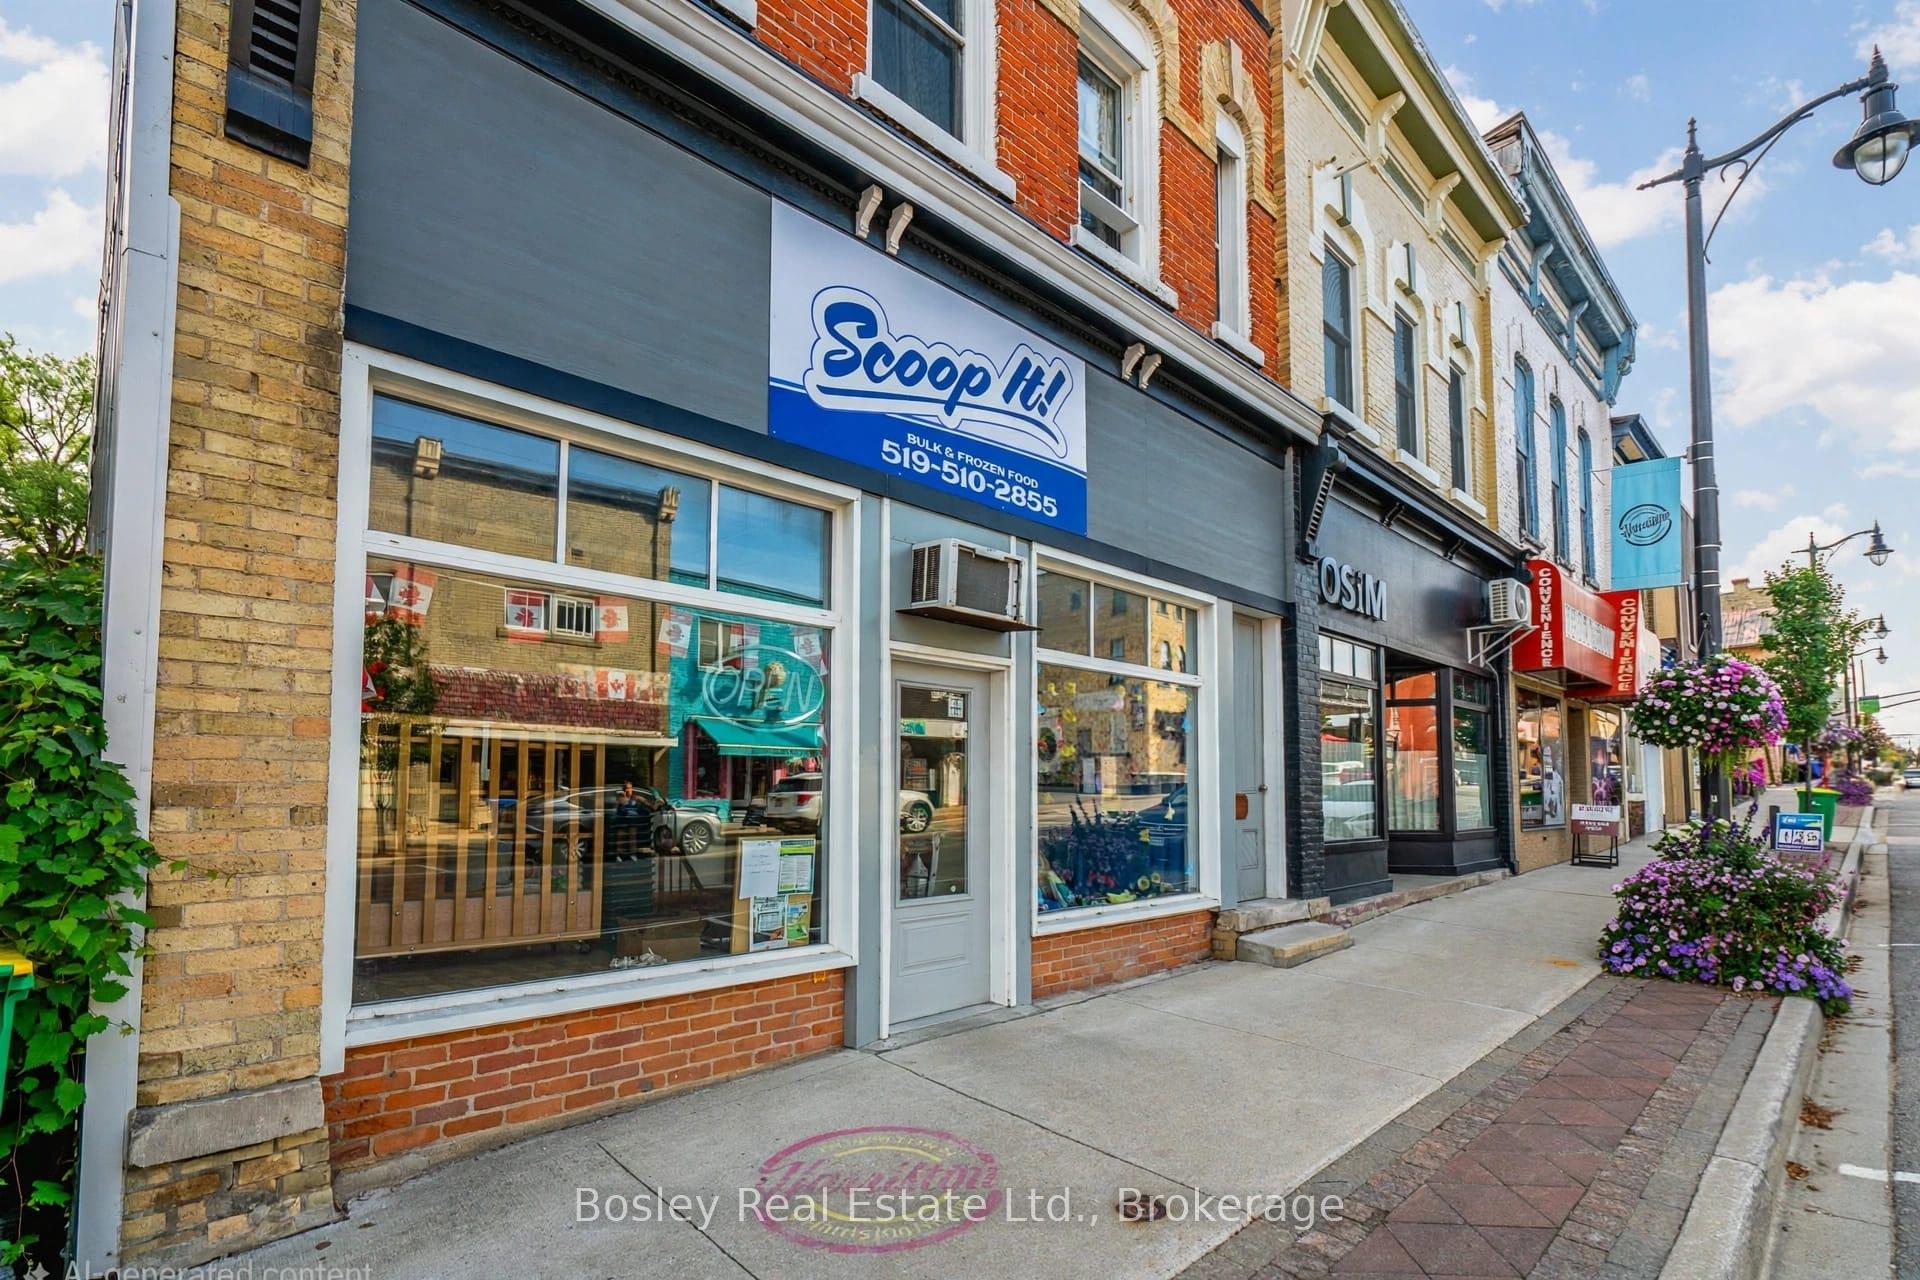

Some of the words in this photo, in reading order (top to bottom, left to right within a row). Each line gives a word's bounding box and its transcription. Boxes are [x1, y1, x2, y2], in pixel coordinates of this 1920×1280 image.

[823, 302, 991, 416] Scoop
[1002, 356, 1066, 417] It!
[881, 439, 1059, 518] 519-510-2855
[907, 433, 942, 454] BULK
[945, 446, 954, 459] &
[957, 452, 1005, 478] FROZEN
[1008, 470, 1038, 489] FOOD
[1538, 568, 1553, 668] CONVENIENCE
[1617, 598, 1637, 692] CONVENIENCE
[709, 665, 817, 713] OPEN
